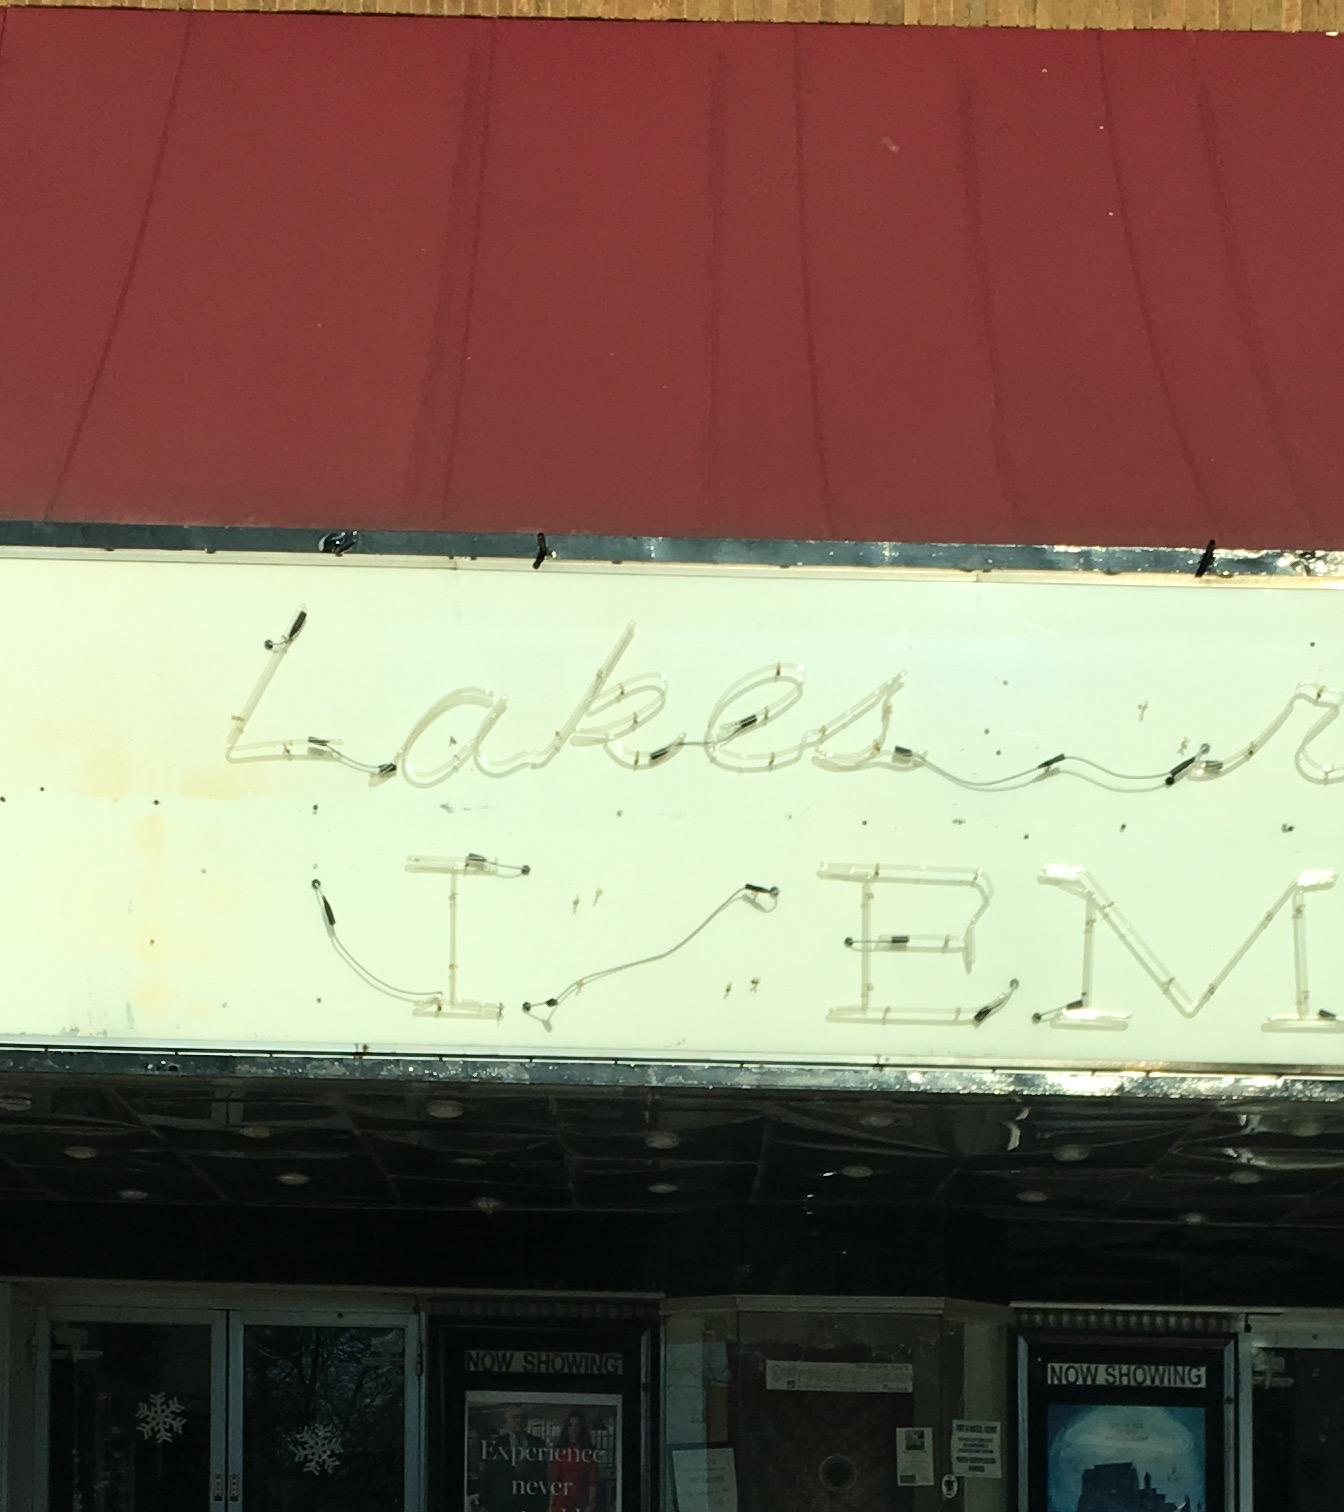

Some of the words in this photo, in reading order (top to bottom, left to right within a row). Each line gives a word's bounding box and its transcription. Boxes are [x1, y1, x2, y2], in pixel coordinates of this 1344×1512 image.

[466, 1350, 514, 1373] NOW
[523, 1352, 623, 1375] SHOWING
[1049, 1364, 1099, 1385] NOW
[1106, 1366, 1203, 1387] SHOWING
[479, 1438, 606, 1467] Experience
[511, 1477, 574, 1496] never
